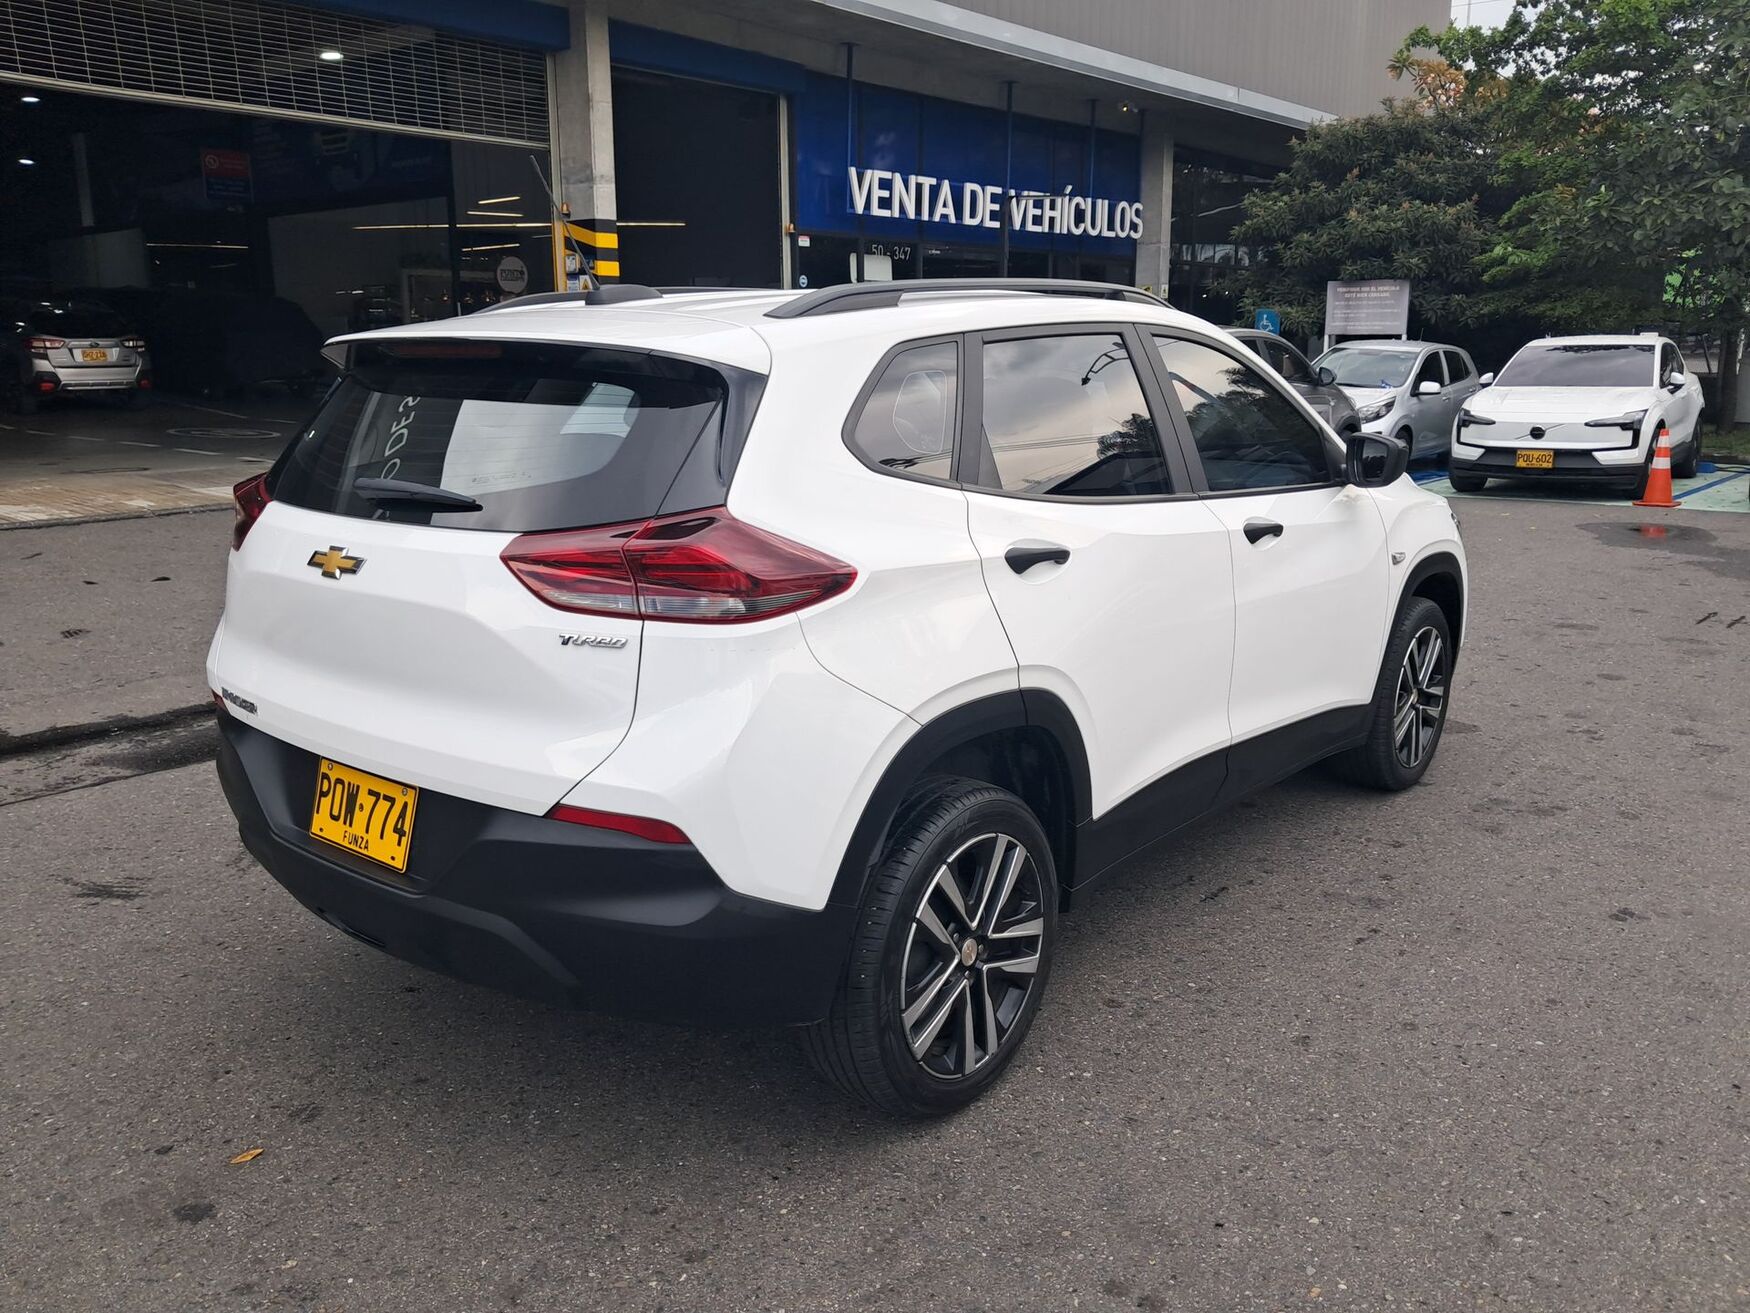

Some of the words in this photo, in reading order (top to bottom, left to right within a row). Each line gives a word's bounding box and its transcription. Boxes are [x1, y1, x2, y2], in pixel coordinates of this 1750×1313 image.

[848, 166, 956, 223] VENTA
[962, 182, 1003, 228] DE
[1008, 185, 1144, 239] VEHÍCULOS
[893, 246, 911, 260] 347
[342, 830, 370, 852] FUNZA
